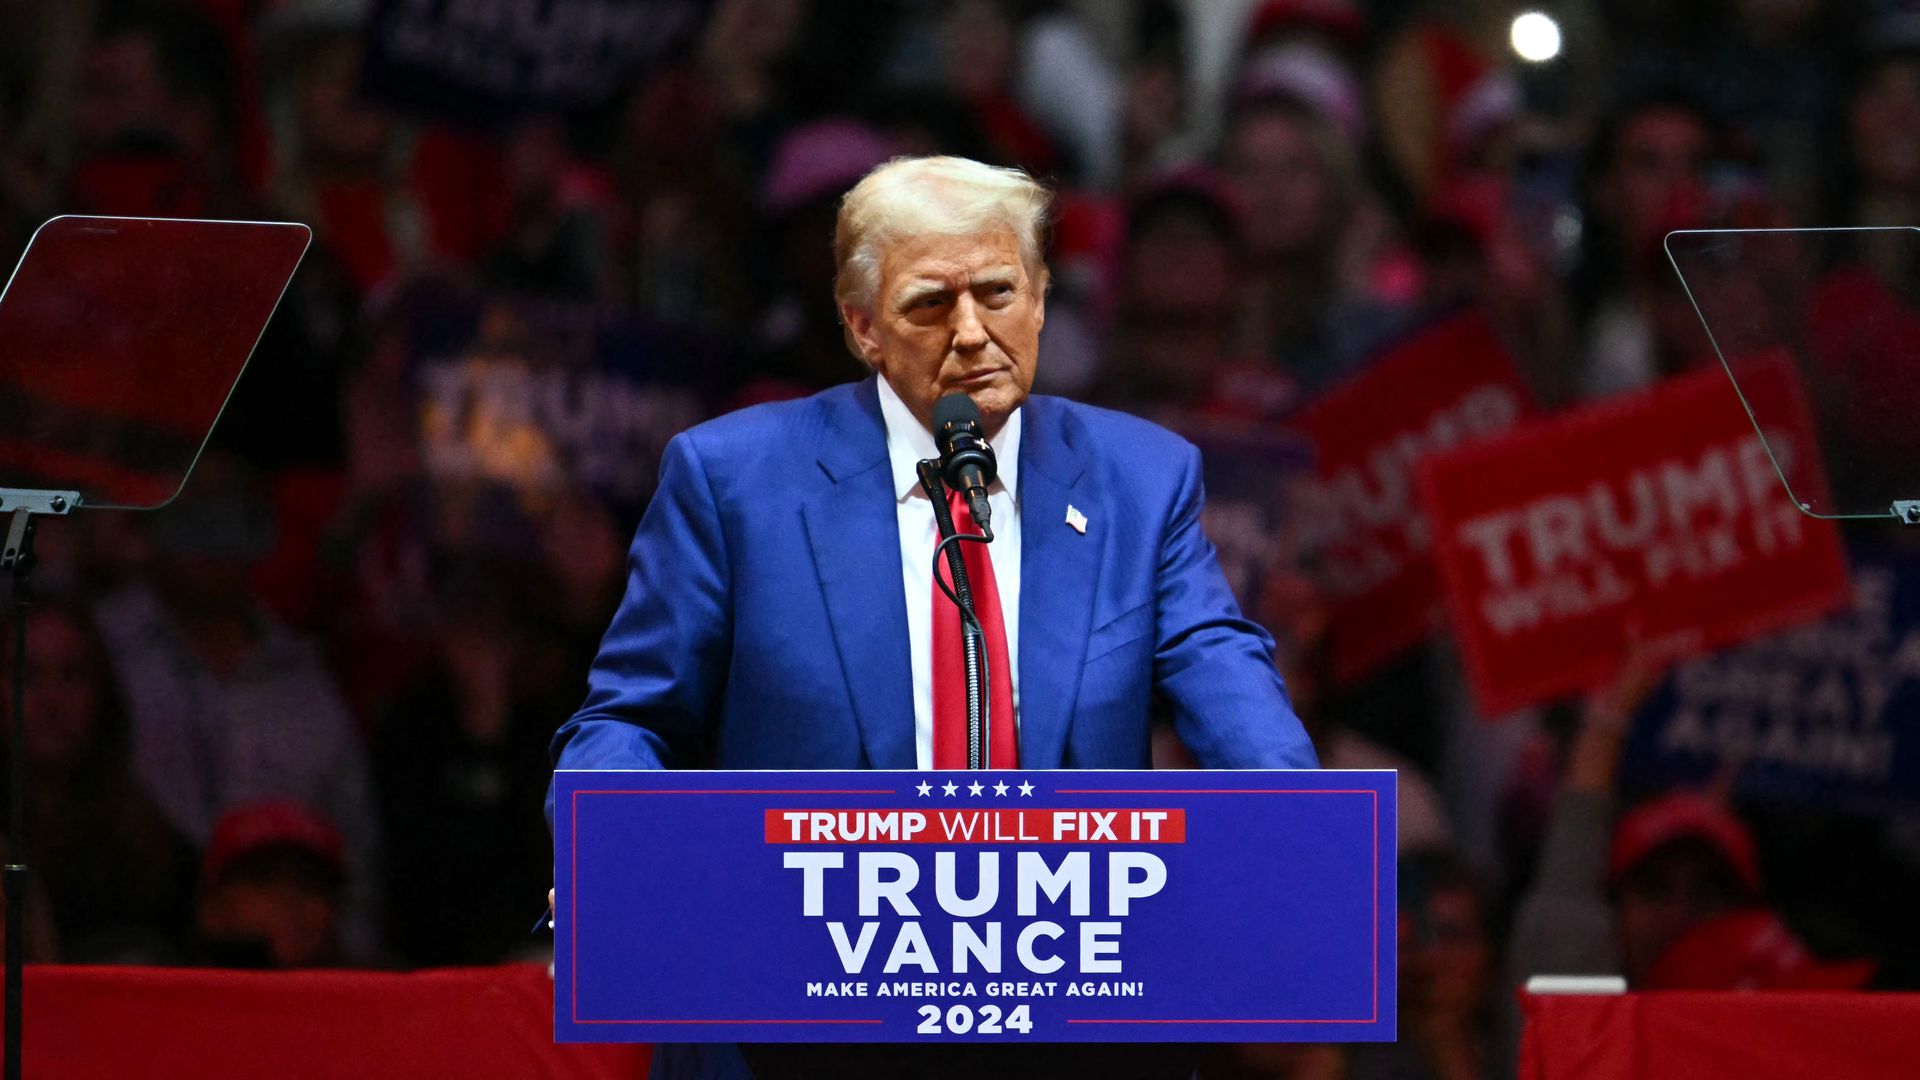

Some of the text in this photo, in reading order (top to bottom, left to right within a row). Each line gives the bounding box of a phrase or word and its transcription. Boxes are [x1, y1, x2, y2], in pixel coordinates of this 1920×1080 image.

[1457, 426, 1797, 590] TRUMP
[1479, 562, 1636, 638] WILL
[1641, 528, 1743, 590] FIX
[1749, 502, 1806, 558] IT
[784, 812, 1167, 841] TRUMP WILL FIX IT
[784, 852, 1167, 917] TRUMP
[826, 921, 1123, 974] VANCE
[807, 982, 1144, 997] MAKE AMERICA GREAT AGAIN!
[917, 1005, 1033, 1034] 2024
